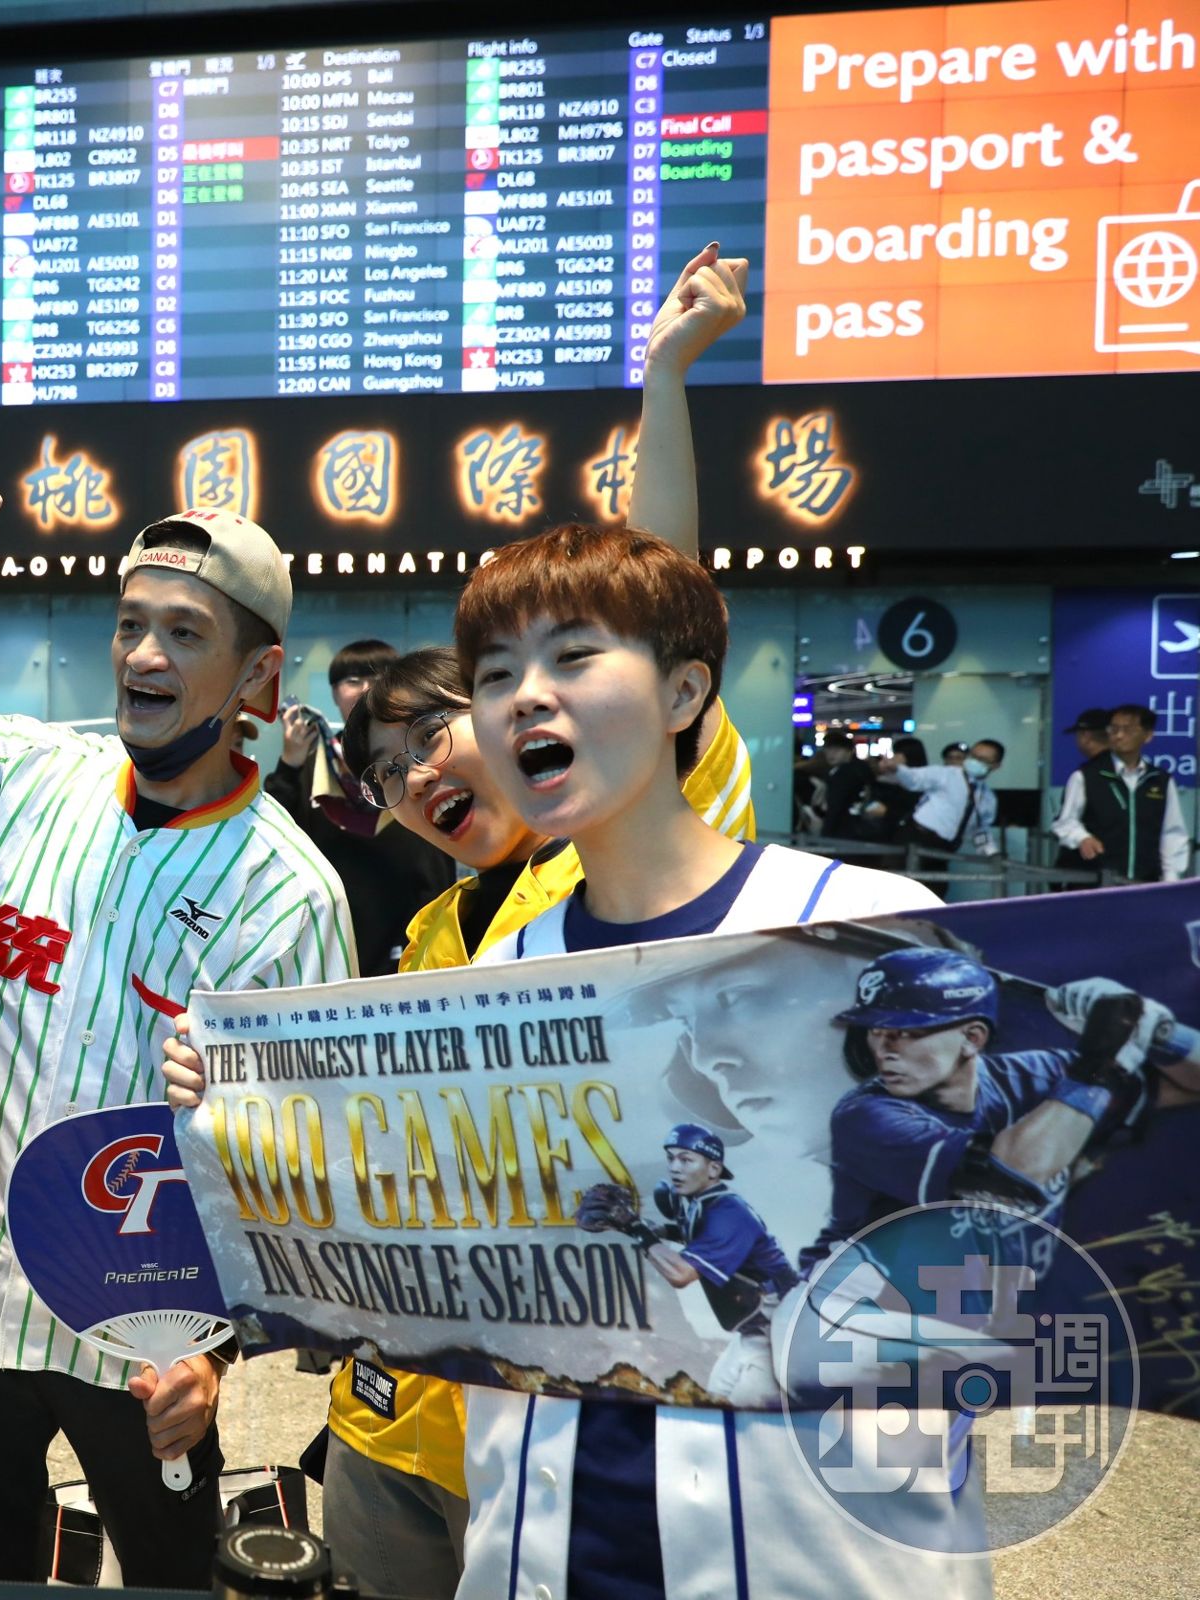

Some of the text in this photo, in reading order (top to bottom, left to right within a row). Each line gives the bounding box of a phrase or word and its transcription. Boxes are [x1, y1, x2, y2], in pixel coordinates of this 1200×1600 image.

[628, 23, 765, 48] Gate Status 1/3
[323, 38, 538, 66] Destination Flight info
[802, 18, 1196, 103] Prepare with
[282, 74, 321, 89] 10:00
[367, 68, 393, 84] Bali
[635, 52, 658, 69] C7
[661, 47, 717, 67] Closed
[282, 95, 321, 111] 10:00
[367, 91, 414, 106] Macau
[281, 117, 320, 133] 10:15
[366, 111, 414, 127] Sendai
[281, 139, 320, 154] 10:35
[366, 134, 409, 151] Tokyo
[661, 118, 699, 135] Final
[701, 115, 732, 133] Call
[281, 160, 320, 176] 10:35
[365, 154, 421, 171] Istanbul
[633, 143, 656, 159] D7
[661, 138, 733, 158] Boarding
[799, 114, 1139, 196] passport &
[281, 182, 320, 198] 10:45
[365, 177, 414, 193] Seattle
[660, 161, 732, 181] Boarding
[280, 204, 319, 220] 11:00
[365, 200, 418, 215] Xiamen
[632, 188, 654, 204] D1
[280, 225, 319, 241] 11:10
[365, 221, 389, 236] San
[391, 219, 450, 235] Francisco
[632, 211, 655, 227] D4
[798, 206, 1069, 272] boarding
[280, 247, 319, 263] 11:15
[365, 244, 418, 262] Ningbo
[279, 269, 318, 285] 11:20
[364, 267, 389, 281] Los
[390, 264, 448, 283] Angeles
[631, 256, 653, 272] C4
[279, 290, 318, 306] 11:25
[364, 287, 415, 303] Fuzhou
[631, 278, 654, 294] D2
[364, 310, 388, 324] San
[389, 308, 449, 323] Francisco
[796, 298, 924, 357] pass
[363, 330, 443, 349] Zhengzhou
[363, 353, 402, 371] Hong
[404, 352, 442, 370] Kong
[278, 377, 317, 393] 12:00
[363, 374, 443, 392] Guangzhou
[139, 551, 187, 567] CANADA
[281, 551, 498, 575] TERNATI
[713, 545, 867, 570] RPORT
[900, 610, 935, 658] 6
[166, 905, 212, 941] MIZUNO
[203, 1018, 217, 1031] 95
[222, 1013, 270, 1031] 戴培峰
[289, 997, 452, 1025] 中職史上最年輕捕手
[205, 1014, 611, 1085] THE YOUNGEST PLAYER TO CATCH
[211, 1080, 642, 1231] 100 GAMES
[104, 1265, 200, 1285] PREMIER12
[244, 1229, 653, 1332] IN A SINGLE SEASON
